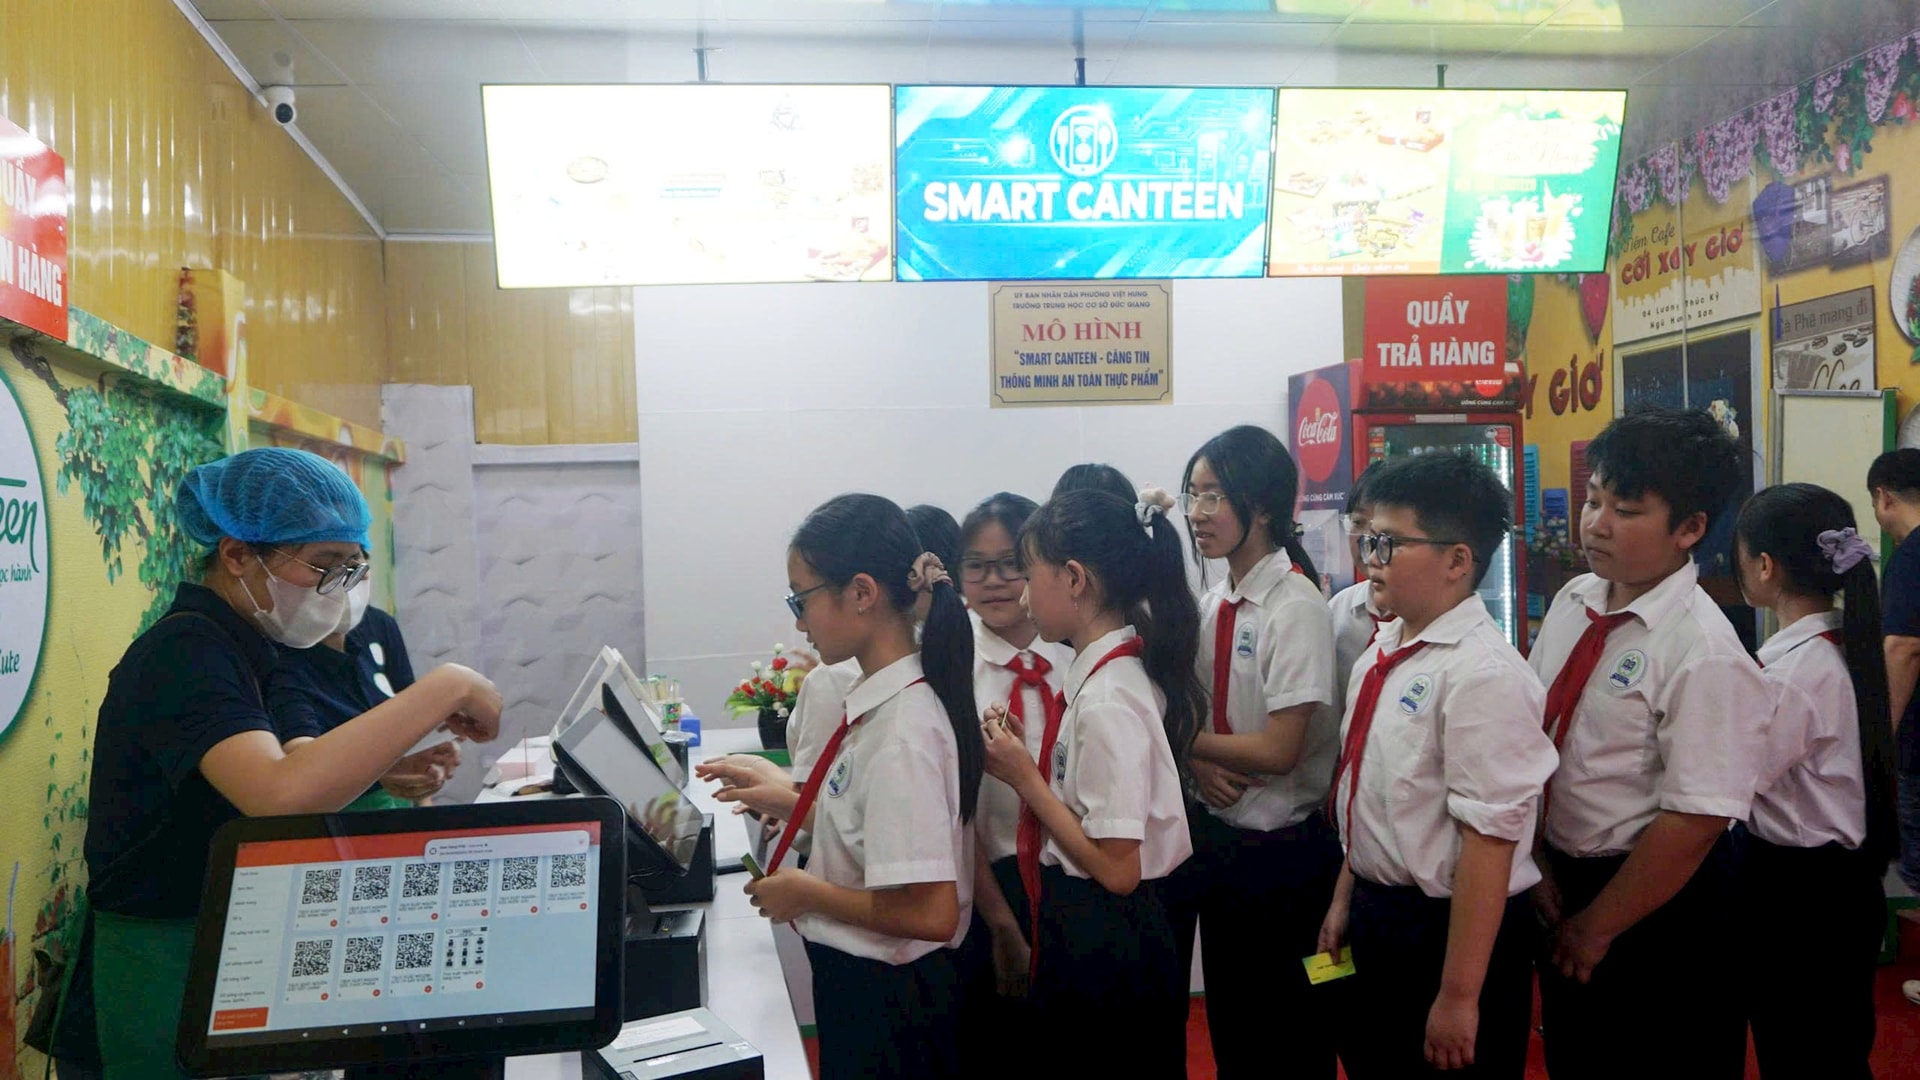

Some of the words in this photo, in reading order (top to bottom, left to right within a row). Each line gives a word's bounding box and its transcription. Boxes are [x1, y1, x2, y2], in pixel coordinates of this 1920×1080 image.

[924, 181, 1060, 221] SMART
[1067, 181, 1245, 221] CANTEEN
[18, 243, 62, 307] HÀNG
[1043, 301, 1065, 309] TRUNG
[1407, 292, 1470, 328] QUẦY
[1819, 306, 1853, 325] mang
[1022, 318, 1067, 342] MÔ
[1074, 317, 1142, 341] HÌNH
[1055, 351, 1097, 365] CANTEEN
[1134, 350, 1150, 364] TIN
[1377, 334, 1422, 367] TRẢ
[1430, 337, 1495, 366] HÀNG
[1000, 373, 1031, 388] THÔNG
[1034, 374, 1059, 388] MINH
[1062, 374, 1075, 387] AN
[1077, 371, 1102, 387] TOÀN
[1104, 371, 1128, 389] THỰC
[0, 496, 40, 574] een
[11, 562, 32, 583] hành
[0, 648, 20, 675] ute
